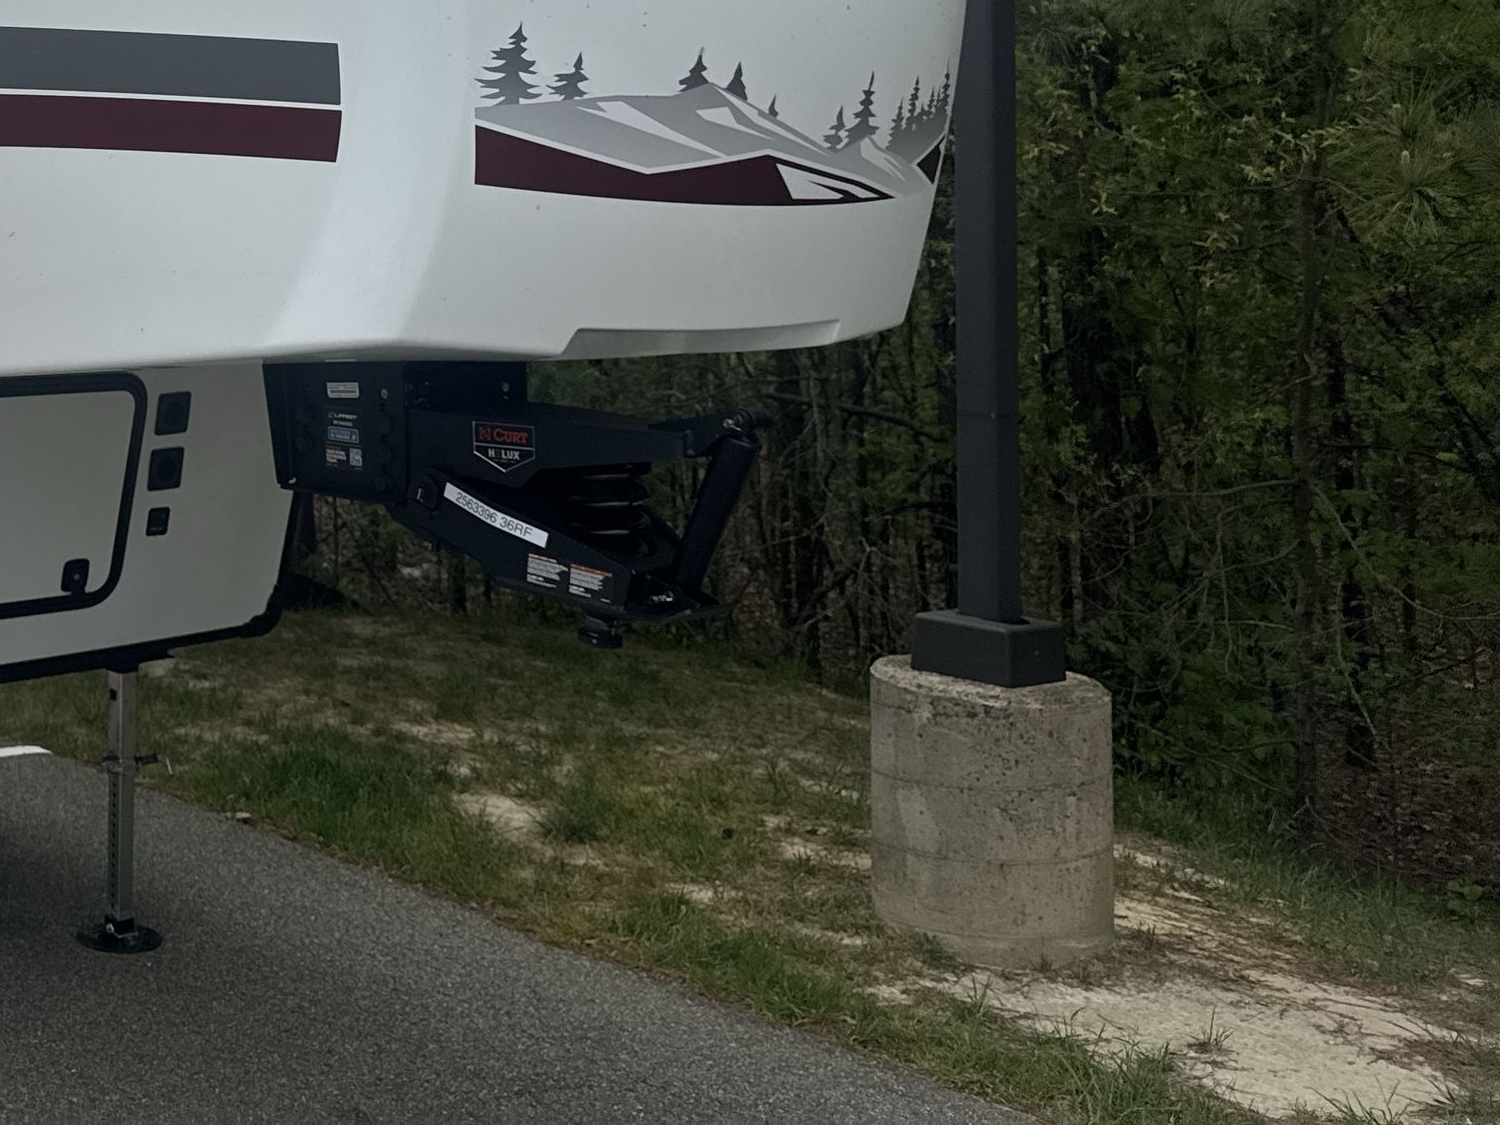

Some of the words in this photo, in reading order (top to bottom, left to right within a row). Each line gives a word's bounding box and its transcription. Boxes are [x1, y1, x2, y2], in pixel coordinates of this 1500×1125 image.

[493, 428, 528, 444] CURT
[455, 491, 498, 523] 2563396
[499, 516, 534, 537] 36RF
